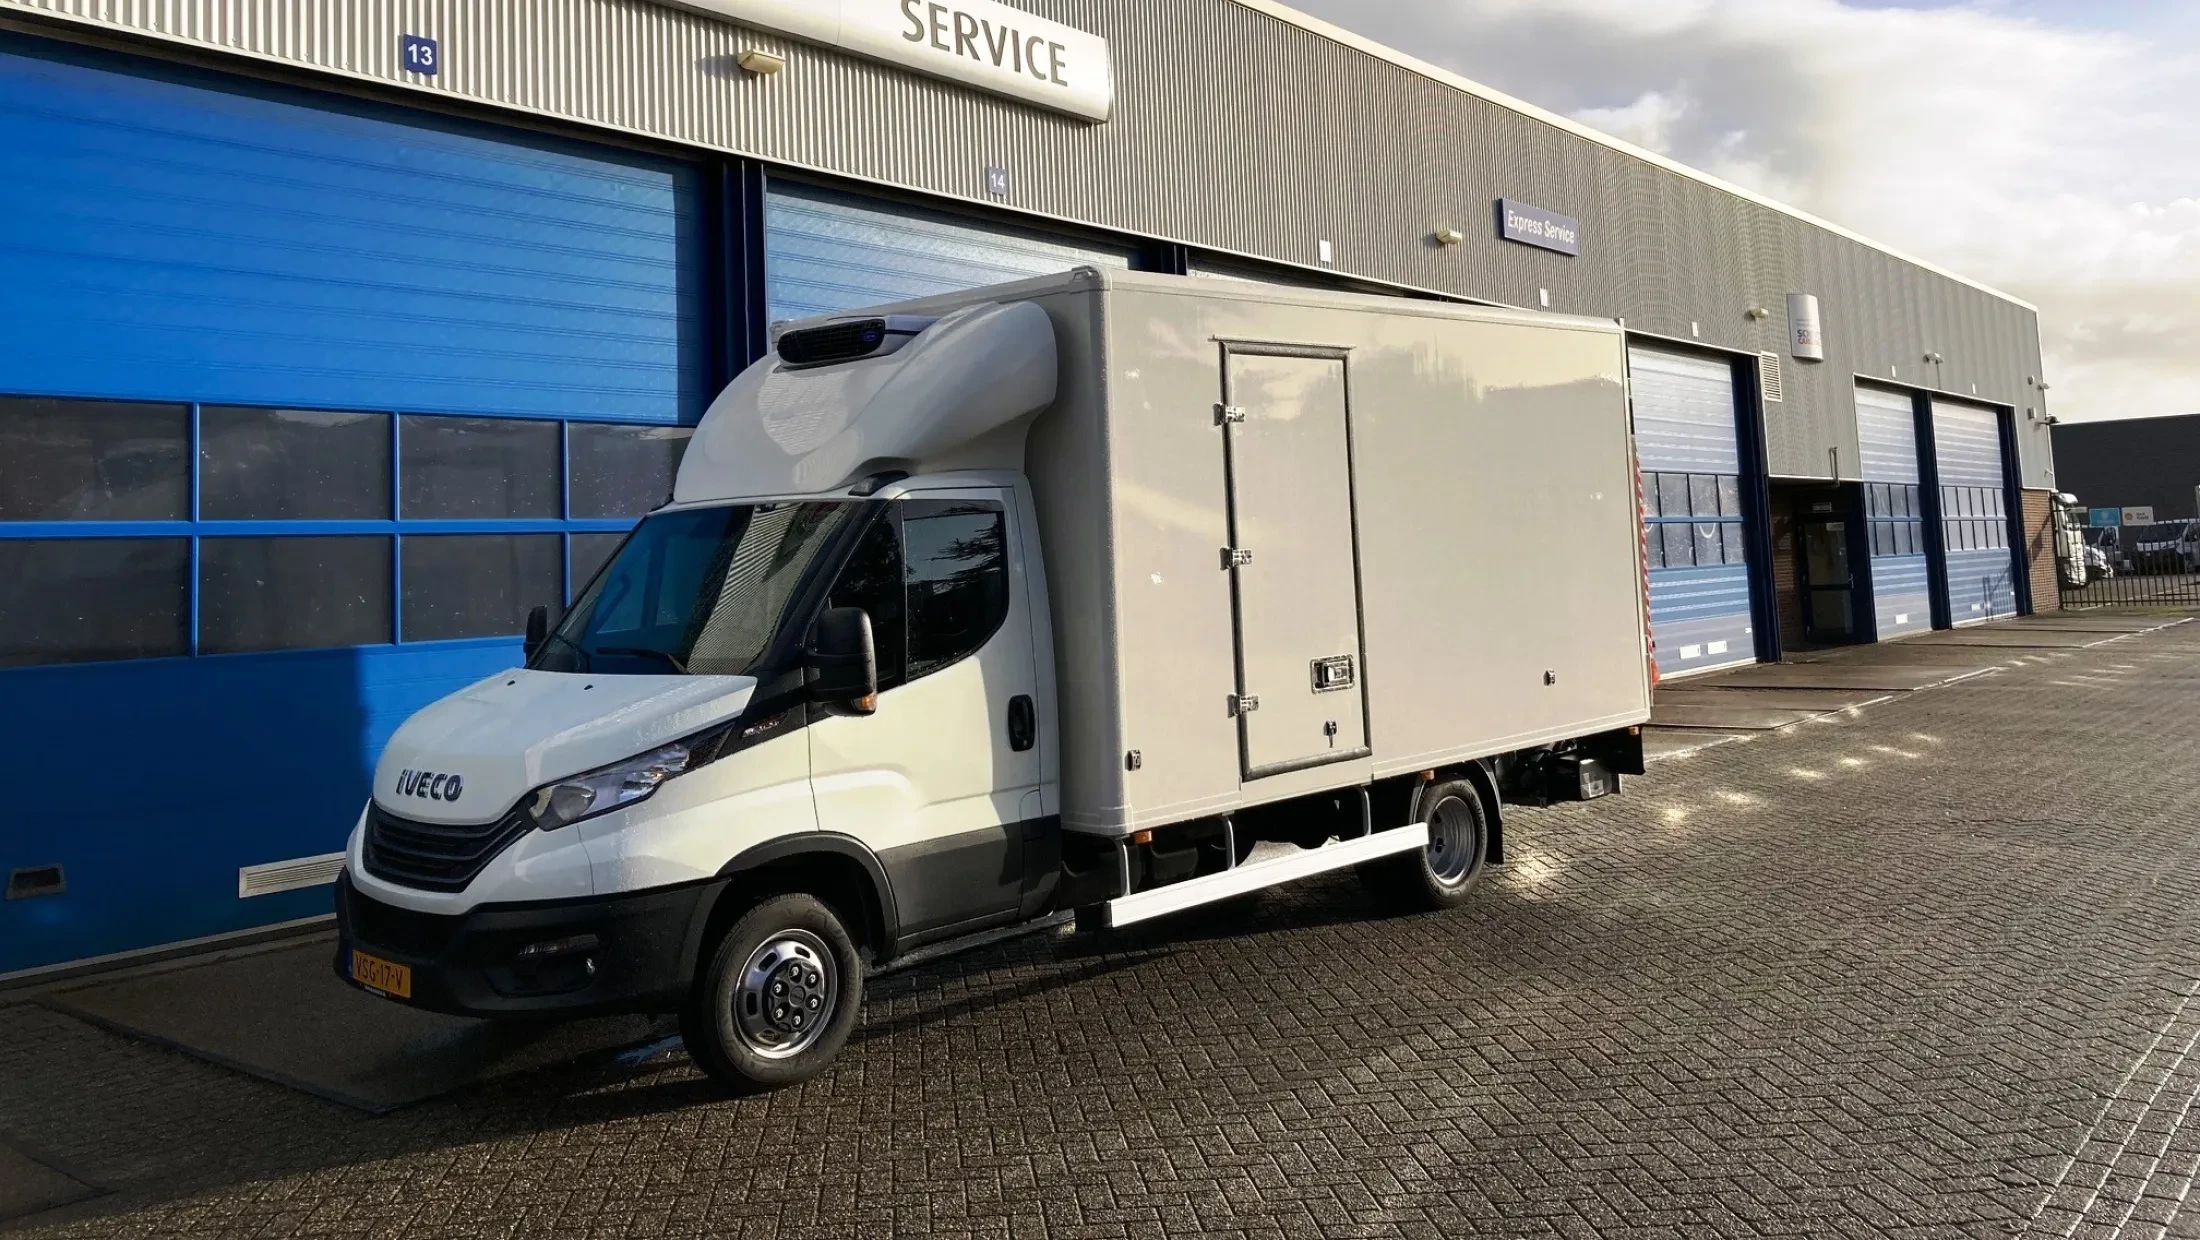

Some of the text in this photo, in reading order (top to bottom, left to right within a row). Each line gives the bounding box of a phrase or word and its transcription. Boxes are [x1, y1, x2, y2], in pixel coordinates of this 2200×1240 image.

[408, 43, 433, 66] 13
[900, 0, 1068, 87] SERVICE
[991, 173, 1005, 189] 14
[1507, 209, 1575, 245] Express Service
[396, 769, 464, 802] IVECO
[355, 954, 404, 991] VSG-17-V
